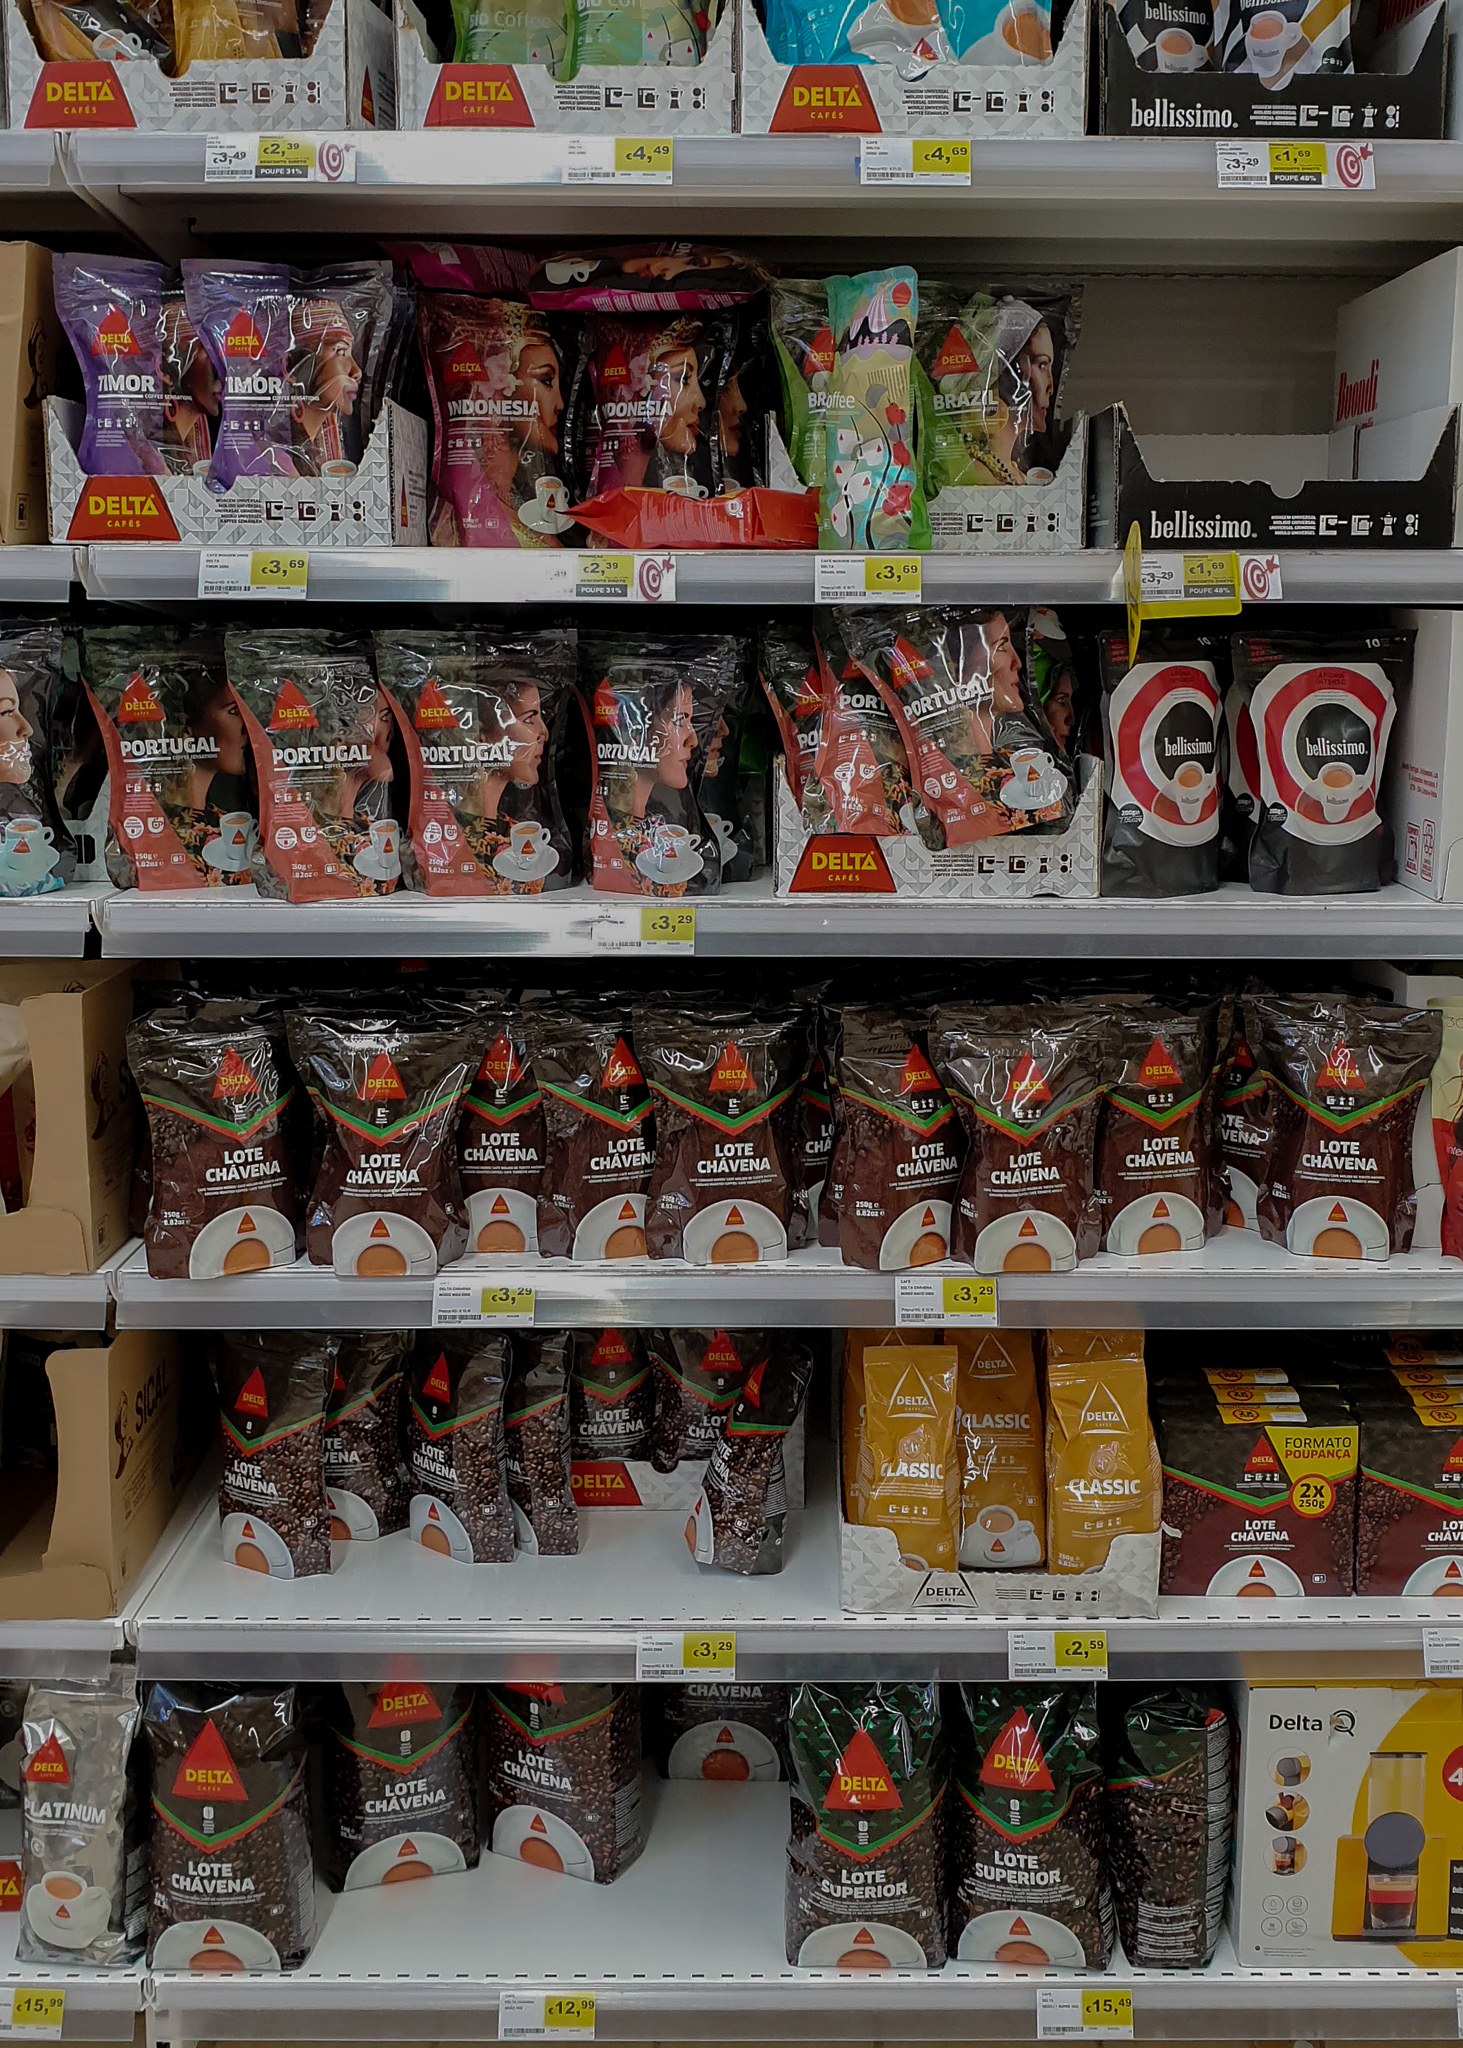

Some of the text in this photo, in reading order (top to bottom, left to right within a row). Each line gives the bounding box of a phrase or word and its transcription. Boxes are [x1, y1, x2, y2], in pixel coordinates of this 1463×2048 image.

[46, 80, 114, 102] DELTA
[446, 80, 514, 101] DELTA
[794, 85, 862, 107] DELTA
[64, 106, 97, 114] CAFÉS
[463, 105, 495, 114] CAFÉS
[810, 111, 844, 120] CAFÉS
[213, 151, 247, 165] €3,49
[263, 143, 300, 157] €2,39
[625, 146, 670, 163] €4,49
[924, 147, 968, 164] €4,69
[1275, 150, 1311, 164] €1,69
[1226, 158, 1259, 171] €3,29
[99, 333, 131, 344] DELTA
[227, 335, 259, 346] DELTA
[453, 362, 482, 373] DELTA
[941, 355, 972, 365] DELTA
[604, 367, 627, 377] DELTA
[933, 391, 999, 410] BRAZIL
[89, 495, 159, 516] DELTA
[107, 518, 141, 528] CAFÉS
[261, 560, 305, 577] €3,69
[583, 562, 619, 576] €2,39
[876, 565, 919, 582] €3,69
[1190, 562, 1225, 576] €1,69
[1142, 571, 1174, 585] €3,29
[1366, 638, 1381, 648] 10
[125, 701, 157, 711] DELTA
[902, 678, 995, 721] PORTUGAL
[278, 707, 310, 718] DELTA
[421, 708, 450, 718] DELTA
[120, 737, 220, 757] PORTUGAL
[272, 744, 372, 765] PORTUGAL
[420, 745, 514, 763] PORTUGAL
[598, 743, 660, 762] ORTUGAL
[812, 850, 878, 871] DELTA
[827, 874, 860, 882] CAFÉS
[651, 915, 693, 932] €3,29
[487, 1060, 516, 1071] DELTA
[1145, 1066, 1174, 1076] DELTA
[221, 1074, 251, 1086] DELTA
[718, 1069, 747, 1079] DELTA
[905, 1069, 930, 1081] DELTA
[368, 1077, 398, 1089] DELTA
[481, 1132, 520, 1146] LOTE
[608, 1137, 646, 1153] LOTE
[1143, 1136, 1180, 1152] LOTE
[224, 1147, 264, 1165] LOTE
[464, 1146, 538, 1162] CHÁVENA
[714, 1142, 754, 1157] LOTE
[911, 1143, 945, 1159] LOTE
[1320, 1140, 1360, 1156] LOTE
[360, 1153, 401, 1168] LOTE
[590, 1151, 657, 1172] CHÁVENA
[697, 1154, 771, 1175] CHÁVENA
[896, 1156, 958, 1177] CHÁVENA
[1009, 1152, 1042, 1169] LOTE
[1125, 1151, 1195, 1168] CHÁVENA
[1302, 1155, 1378, 1172] CHÁVENA
[205, 1161, 281, 1182] CHÁVENA
[347, 1165, 420, 1190] CHÁVENA
[990, 1166, 1060, 1185] CHÁVENA
[491, 1287, 532, 1305] €3,29
[953, 1286, 994, 1304] €3,29
[599, 1345, 624, 1356] DELTA
[709, 1352, 735, 1362] DELTA
[977, 1359, 1007, 1369] DELTA
[897, 1395, 929, 1407] DELTA
[595, 1409, 630, 1422] LOTE
[962, 1413, 1030, 1430] CLASSIC
[1087, 1411, 1120, 1421] DELTA
[580, 1419, 644, 1435] CHÁVENA
[421, 1442, 446, 1460] LOTE
[1284, 1437, 1351, 1449] FORMATO
[1252, 1456, 1274, 1464] DELTA
[1285, 1450, 1351, 1461] POUPANÇA
[233, 1459, 262, 1479] LOTE
[412, 1451, 458, 1480] CHÁVENA
[570, 1474, 625, 1490] DELTA
[1069, 1479, 1141, 1495] CLASSIC
[1299, 1499, 1325, 1509] 250g
[1245, 1520, 1276, 1531] LOTE
[1231, 1529, 1289, 1542] CHÁVENA
[926, 1587, 966, 1598] DELTA
[693, 1641, 733, 1660] €3,29
[1065, 1640, 1104, 1658] €2,59
[382, 1693, 429, 1712] DELTA
[1269, 1714, 1323, 1731] Delta
[34, 1762, 63, 1773] DELTA
[517, 1750, 554, 1772] LOTE
[993, 1753, 1040, 1772] DELTA
[185, 1769, 233, 1784] DELTA
[503, 1760, 573, 1791] CHÁVENA
[385, 1778, 428, 1798] LOTE
[840, 1776, 888, 1792] DELTA
[364, 1791, 447, 1814] CHÁVENA
[25, 1800, 106, 1824] PLATINUM
[994, 1851, 1039, 1869] LOTE
[188, 1861, 233, 1877] LOTE
[841, 1869, 886, 1884] LOTE
[975, 1863, 1061, 1885] SUPERIOR
[172, 1874, 255, 1893] CHÁVENA
[821, 1880, 908, 1899] SUPERIOR
[17, 1998, 63, 2015] €15,99
[548, 2000, 595, 2018] €12,99
[1086, 1998, 1132, 2015] €15,49
